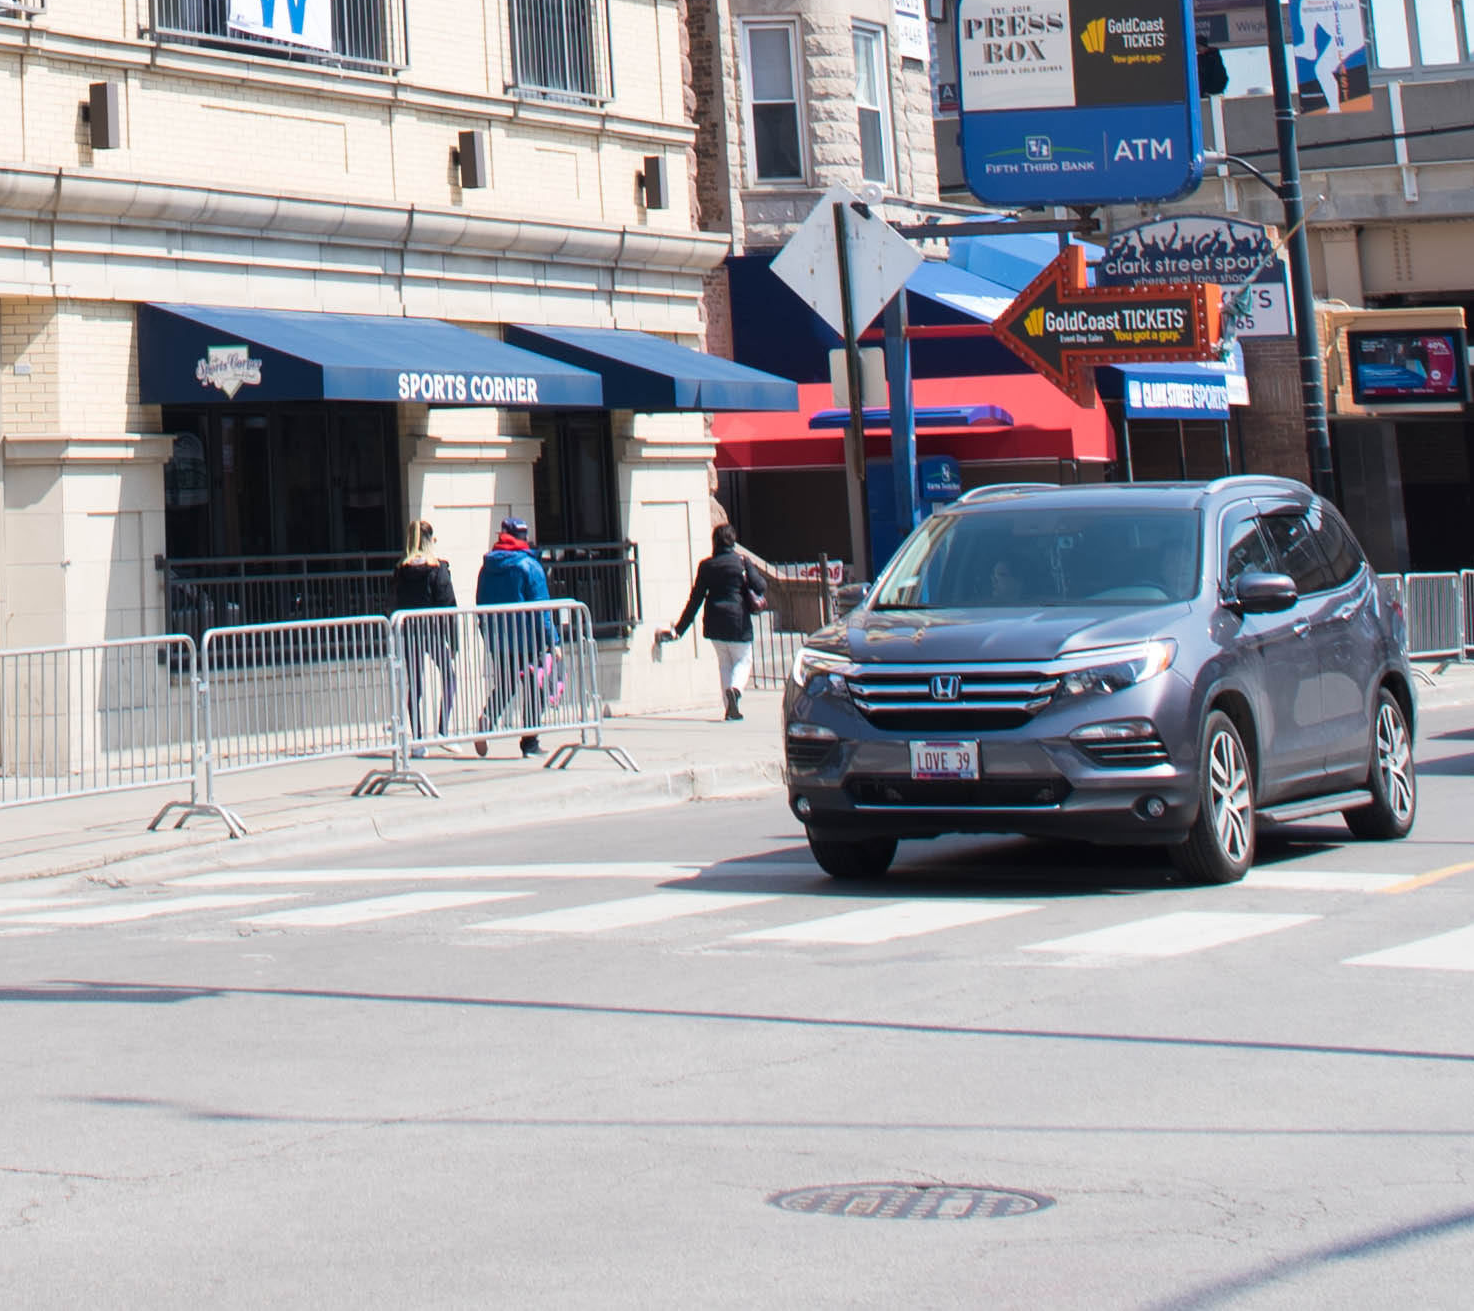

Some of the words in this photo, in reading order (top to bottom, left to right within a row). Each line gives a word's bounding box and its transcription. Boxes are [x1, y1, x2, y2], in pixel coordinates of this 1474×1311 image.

[962, 12, 1064, 40] PRESS
[1107, 16, 1165, 34] GoldCoast
[1122, 33, 1165, 49] TICKETS
[982, 39, 1046, 64] BOX
[942, 85, 954, 98] A
[1114, 138, 1173, 162] ATM
[1105, 257, 1152, 275] clark
[1155, 255, 1210, 273] street
[1214, 254, 1274, 274] sports
[1133, 275, 1167, 286] where
[1169, 274, 1191, 285] real
[1193, 273, 1217, 285] fans
[1045, 310, 1119, 332] GoldCoast
[1121, 308, 1184, 330] TICKETS
[1060, 334, 1075, 343] Event
[1076, 334, 1087, 344] Day
[1088, 333, 1104, 343] Sales
[1113, 330, 1132, 341] You
[1133, 330, 1151, 343] got
[1151, 331, 1159, 340] a
[398, 372, 467, 401] SPORTS
[470, 375, 539, 403] CORNER
[1194, 383, 1229, 410] SPORTS
[917, 752, 949, 770] LOVE
[956, 752, 970, 770] 39
